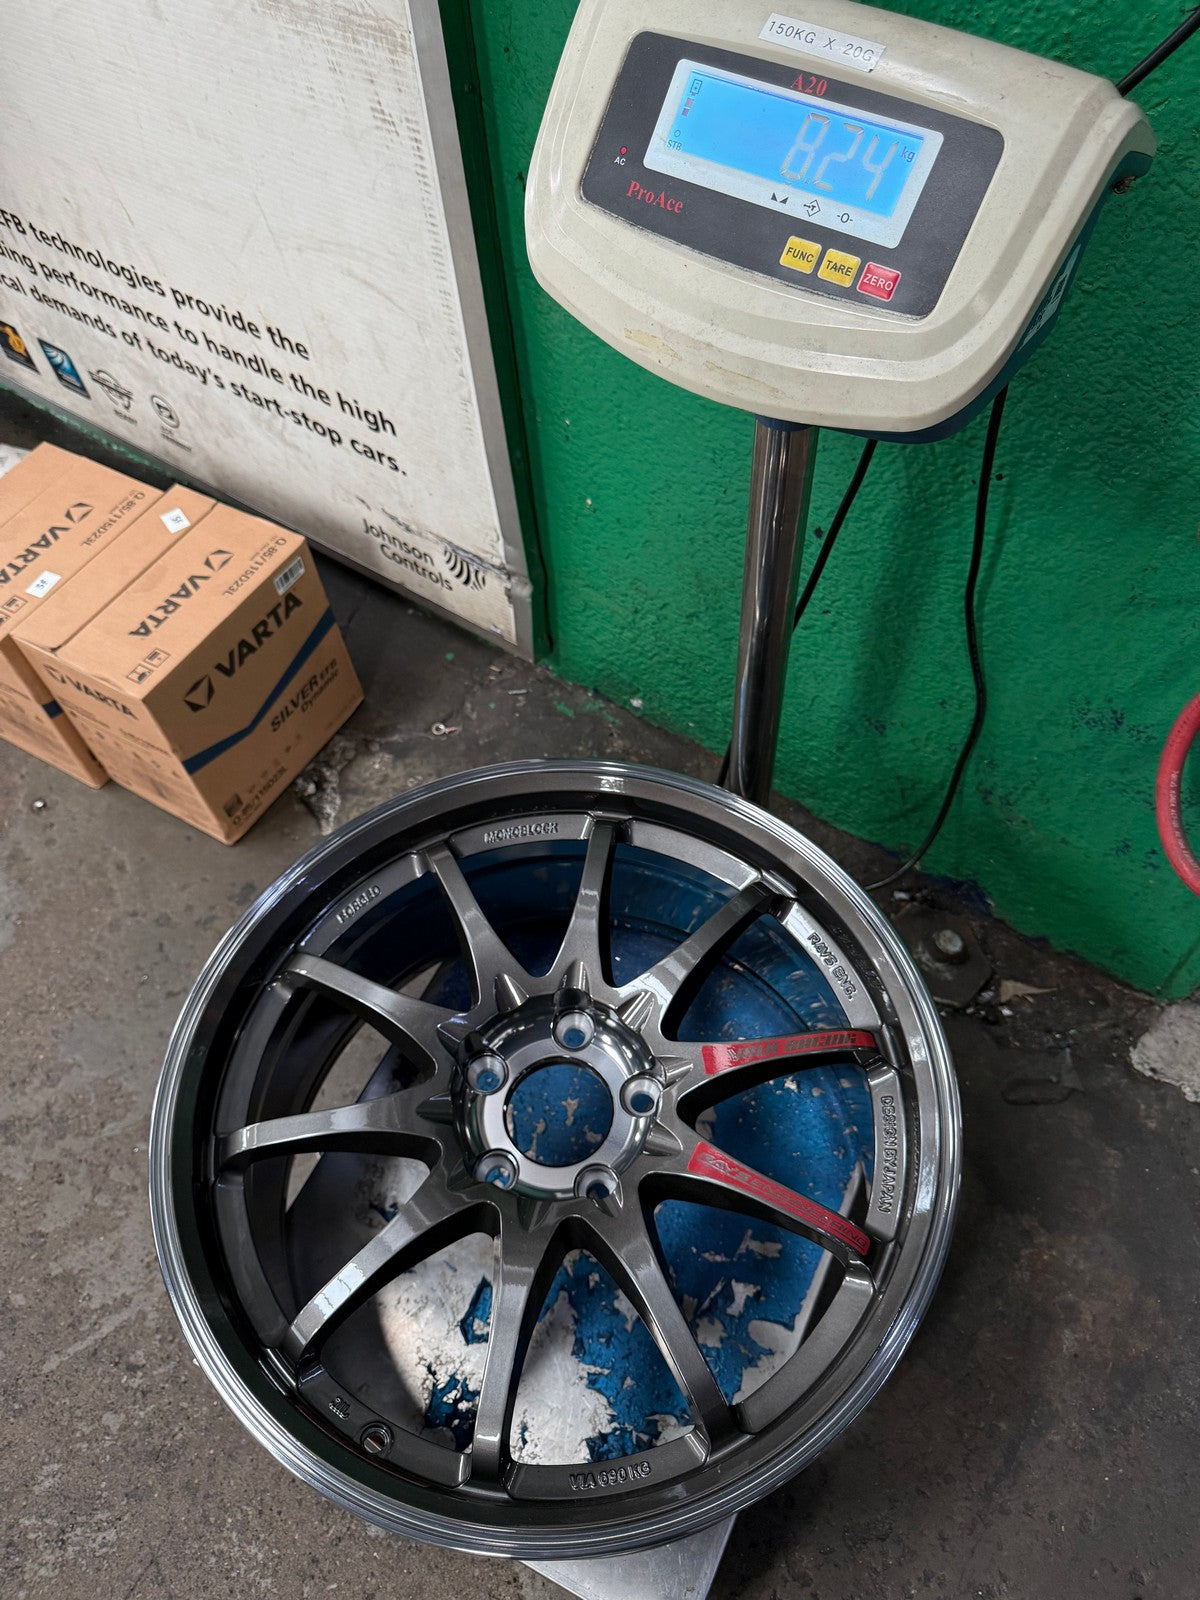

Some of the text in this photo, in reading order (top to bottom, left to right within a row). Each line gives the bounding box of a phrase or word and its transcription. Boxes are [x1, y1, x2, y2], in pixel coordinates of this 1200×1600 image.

[768, 20, 875, 62] 150KG X 20G
[790, 73, 827, 97] A20
[613, 156, 626, 166] AC
[667, 139, 683, 151] STB
[901, 146, 916, 163] kg
[626, 180, 684, 214] ProAce
[785, 246, 815, 264] FUNC
[825, 259, 854, 278] TARE
[29, 222, 166, 297] technologies
[170, 287, 261, 339] provide
[267, 325, 310, 361] the
[863, 273, 894, 292] ZERO
[38, 260, 170, 333] performance
[173, 320, 199, 345] to
[202, 331, 284, 384] handle
[289, 372, 332, 407] the
[337, 391, 397, 437] high
[30, 284, 118, 339] demands
[121, 331, 144, 352] of
[146, 336, 226, 390] today's
[230, 380, 342, 447] start-stop
[350, 436, 407, 477] cars.
[362, 518, 436, 567] Johnson
[380, 543, 453, 592] Controls
[128, 574, 212, 638] VARTA
[214, 592, 303, 678] VARTA
[270, 674, 318, 732] SILVER
[878, 1095, 898, 1214] DESIGN BY JAPAN
[598, 1467, 628, 1487] 690
[628, 1460, 652, 1481] KG
